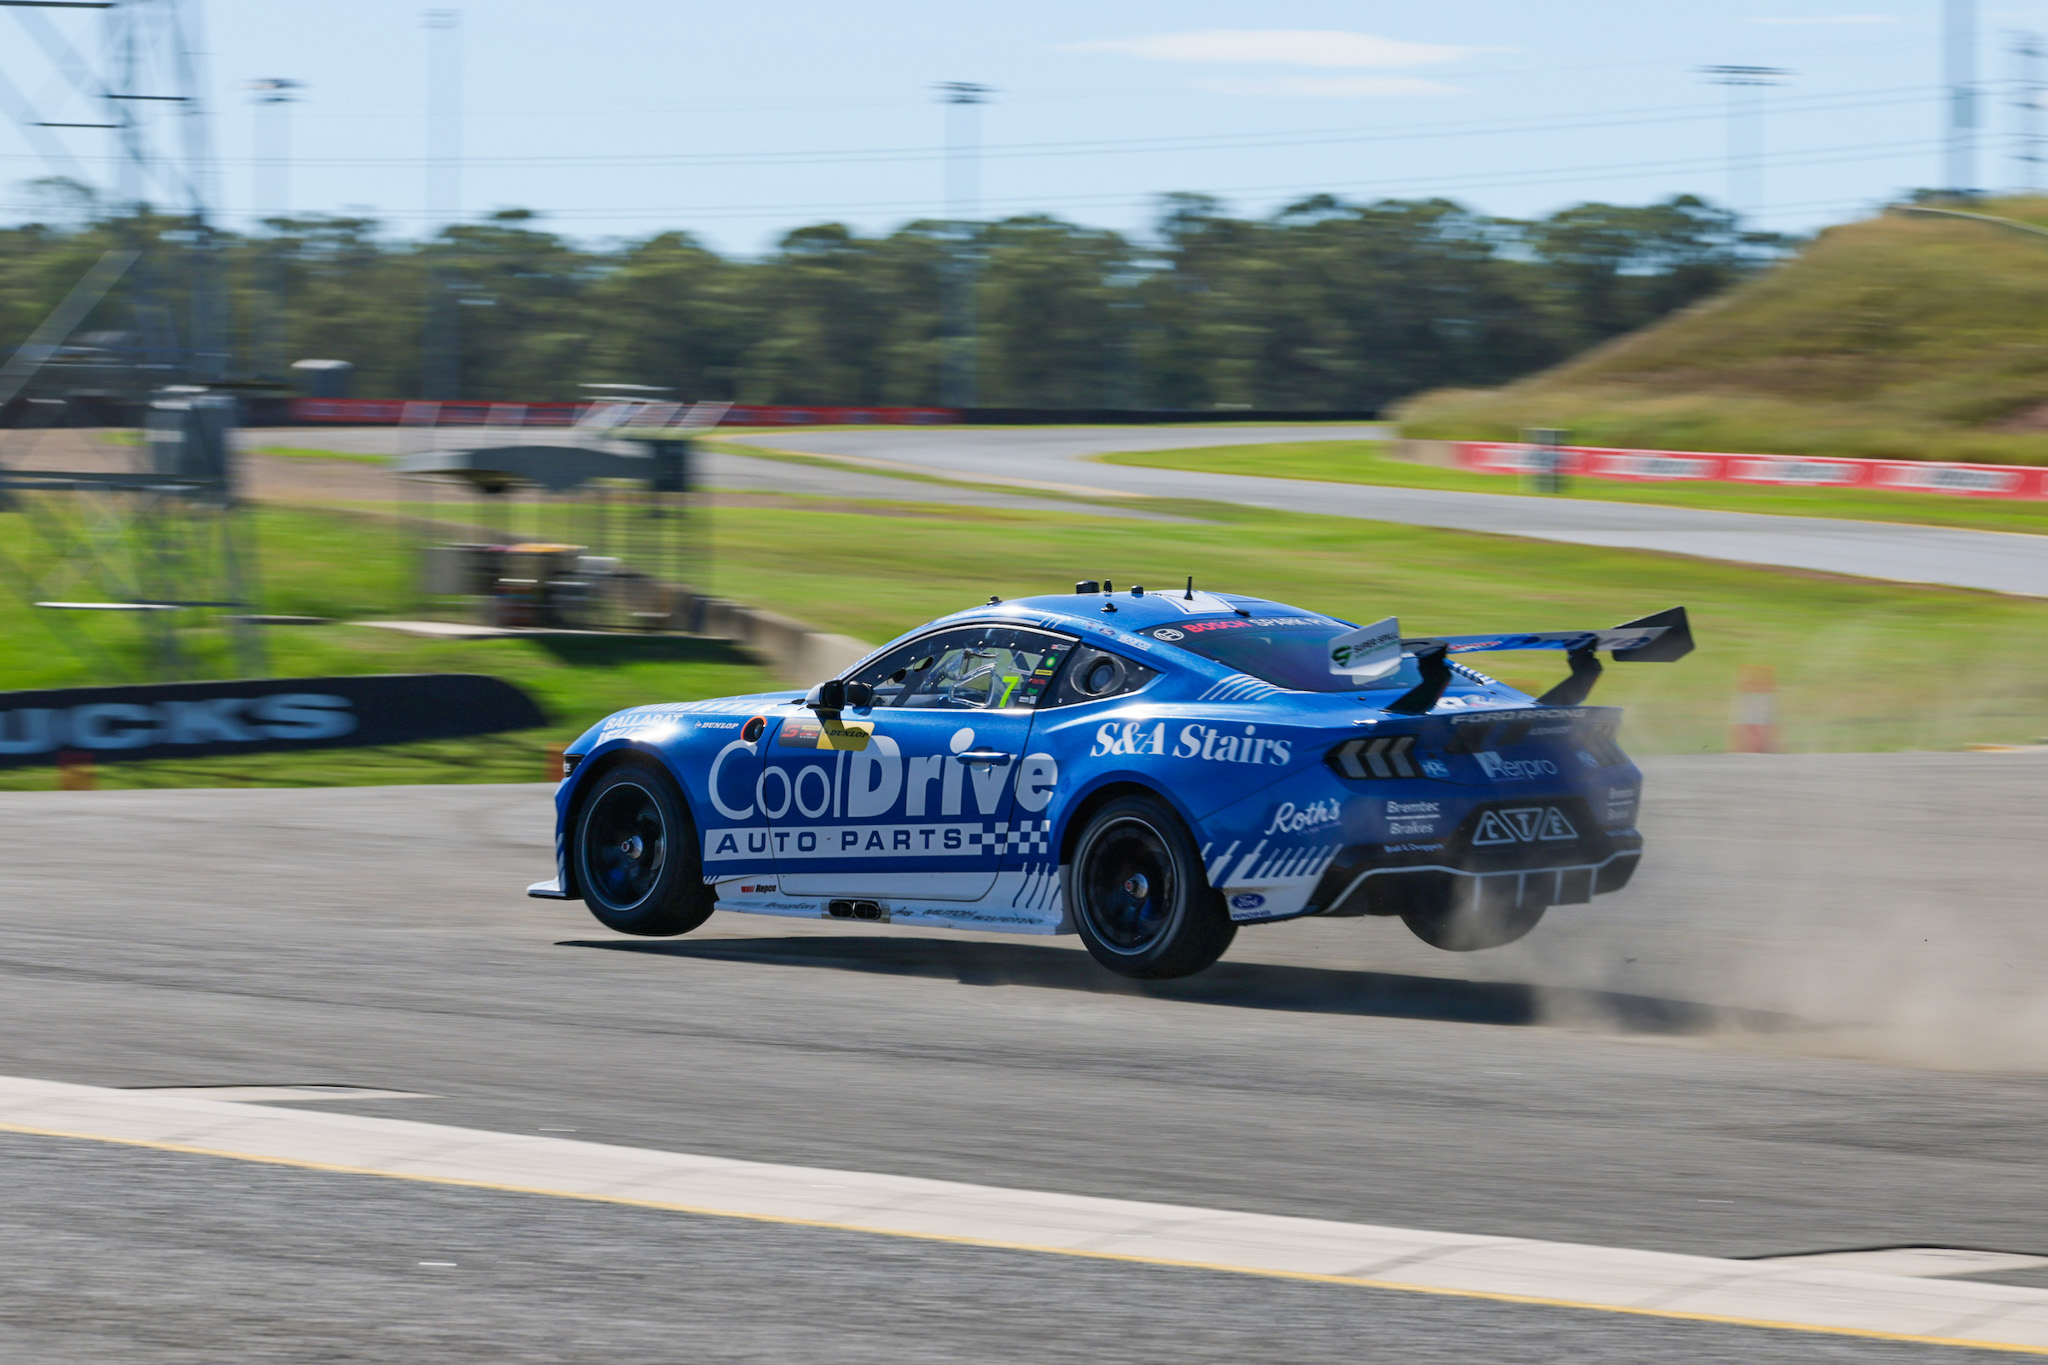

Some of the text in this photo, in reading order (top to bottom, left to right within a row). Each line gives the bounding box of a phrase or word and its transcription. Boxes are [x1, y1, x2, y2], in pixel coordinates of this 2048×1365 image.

[1182, 620, 1252, 634] BOSCH
[998, 675, 1019, 708] 7
[1450, 708, 1589, 724] FORD RACING
[701, 721, 739, 730] DUNLOP
[829, 729, 869, 738] DUNLOP
[1089, 722, 1292, 766] S&A Stairs
[1472, 751, 1559, 780] Aerpro
[1386, 801, 1440, 814] Bremtec
[1265, 798, 1341, 836] Roth's
[1389, 821, 1435, 835] Brakes
[715, 828, 962, 854] AUTO PARTS
[755, 884, 777, 894] Repco
